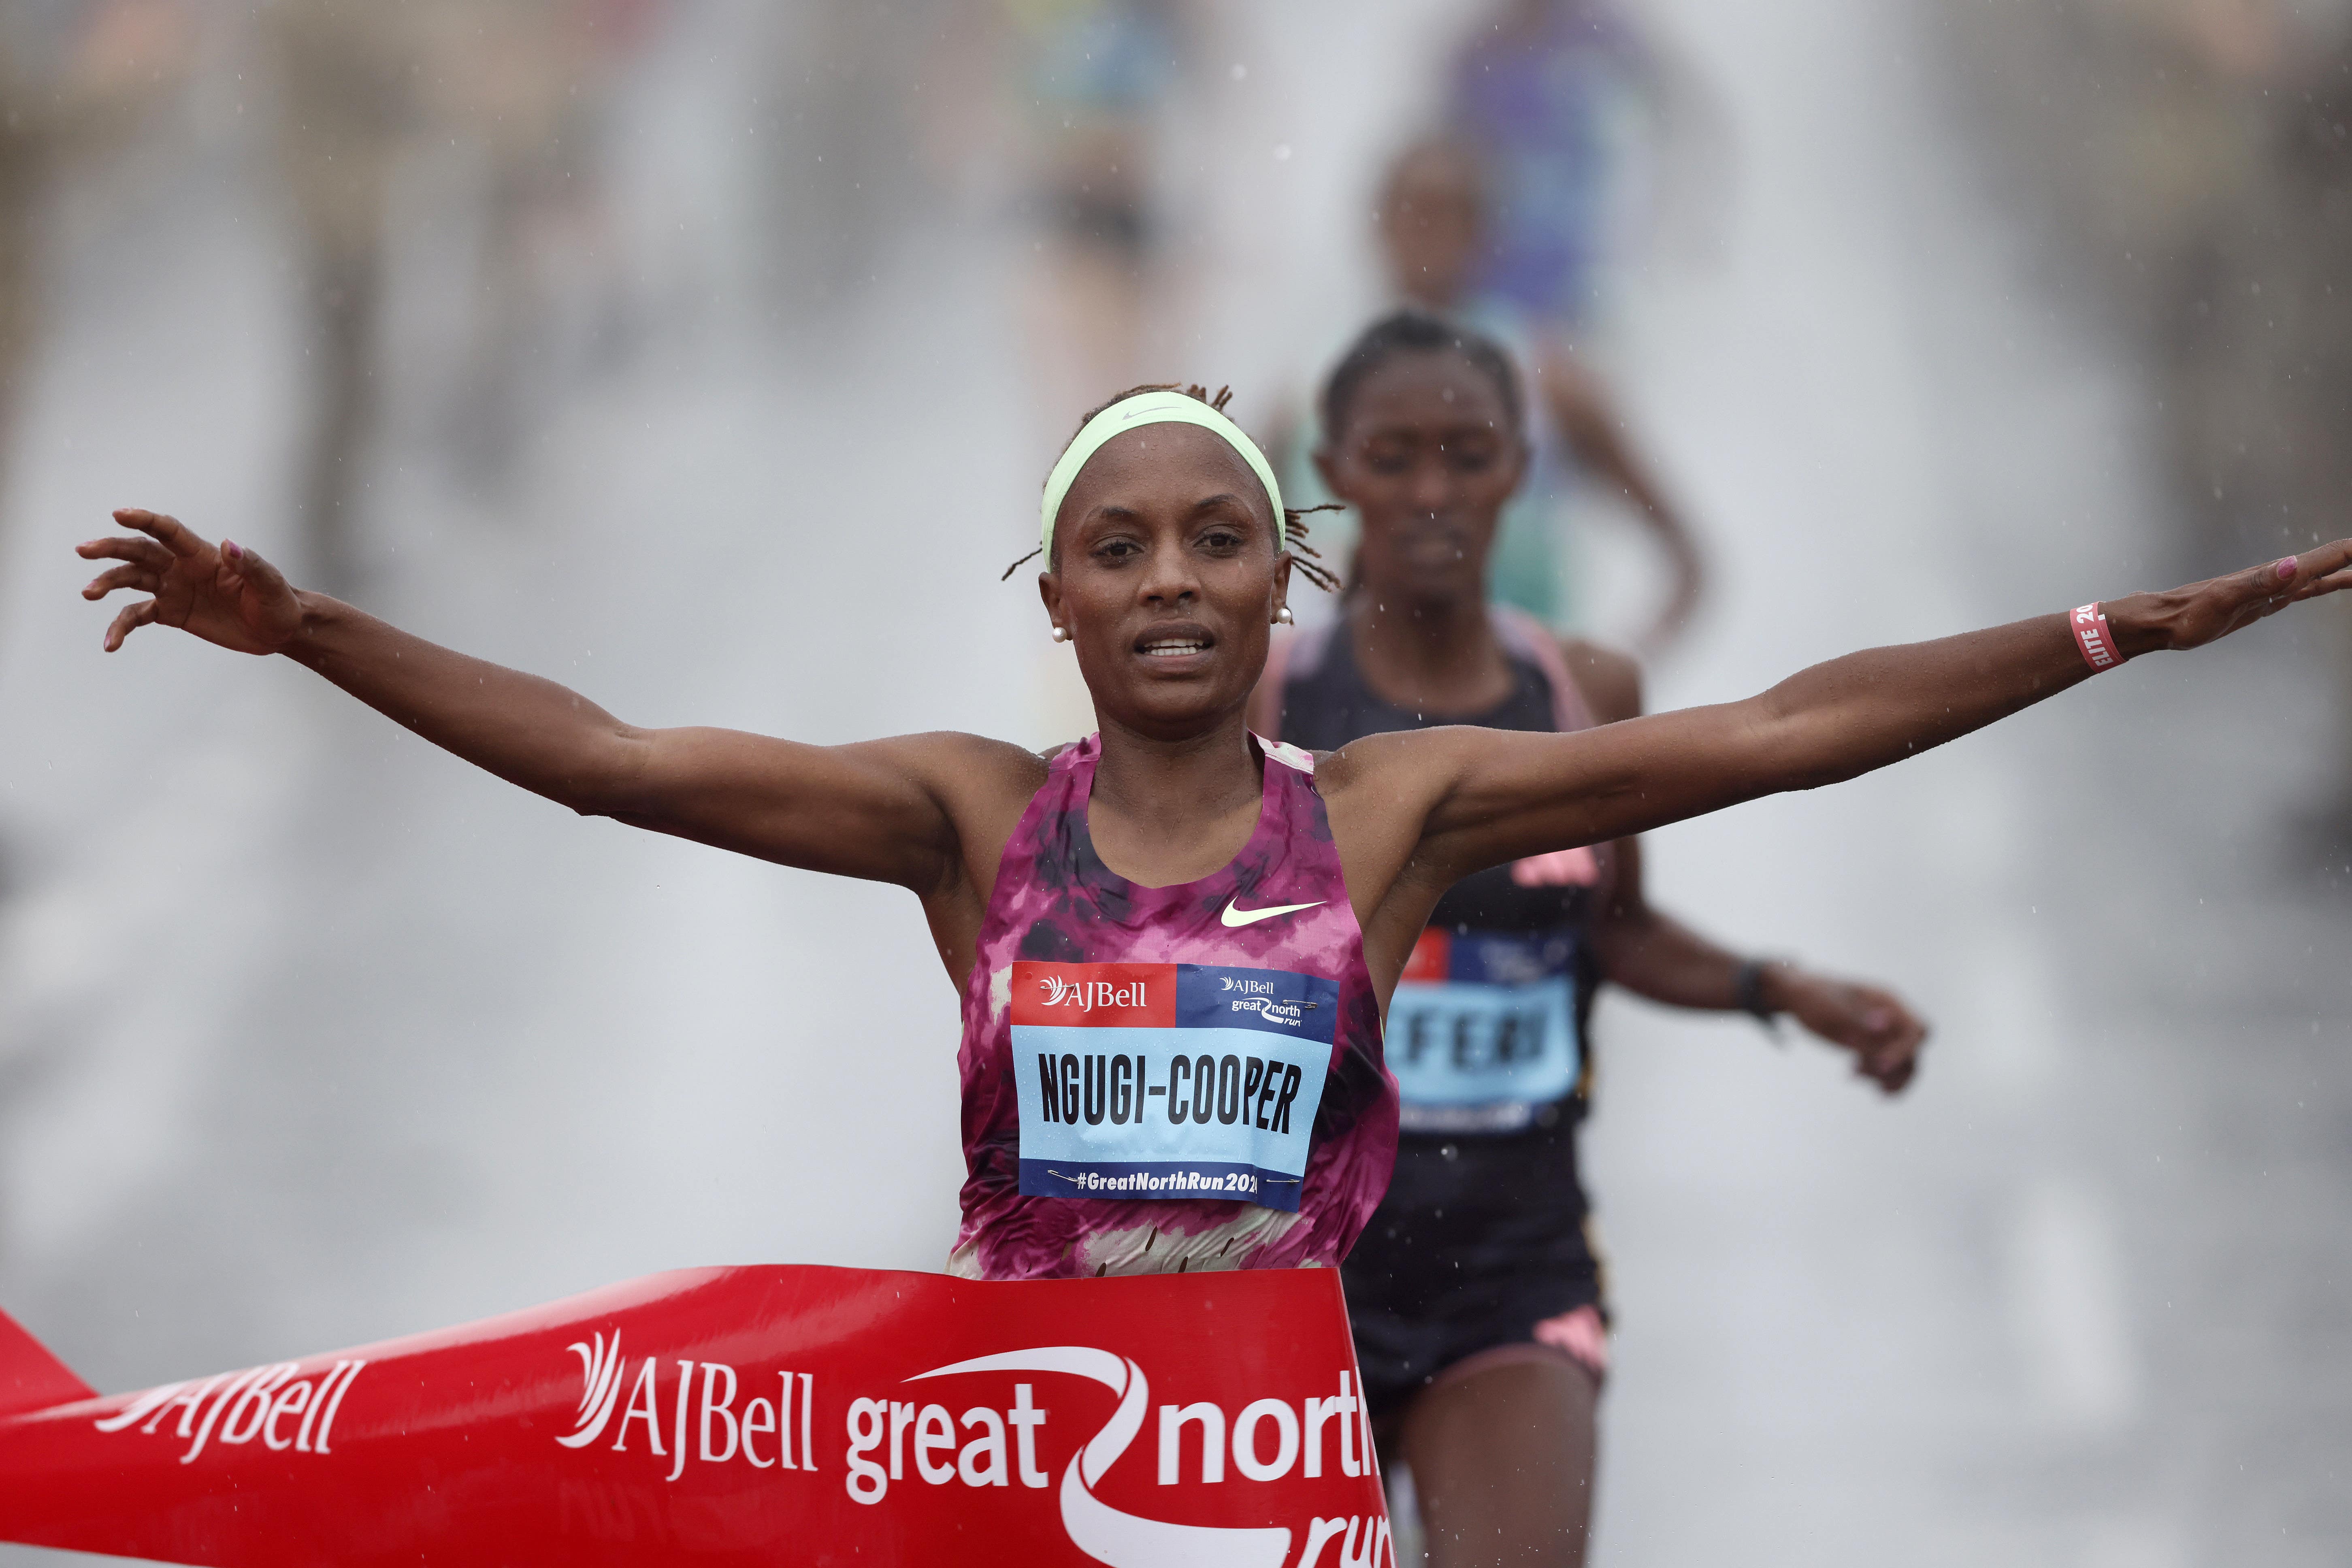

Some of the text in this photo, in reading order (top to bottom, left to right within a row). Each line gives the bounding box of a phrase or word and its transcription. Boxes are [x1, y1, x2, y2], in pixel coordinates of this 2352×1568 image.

[2076, 603, 2114, 666] ELITE 20
[1231, 1000, 1300, 1017] great north
[1284, 1018, 1301, 1027] run
[1038, 1053, 1302, 1135] NGUGI-COOPER
[845, 1383, 1049, 1505] great
